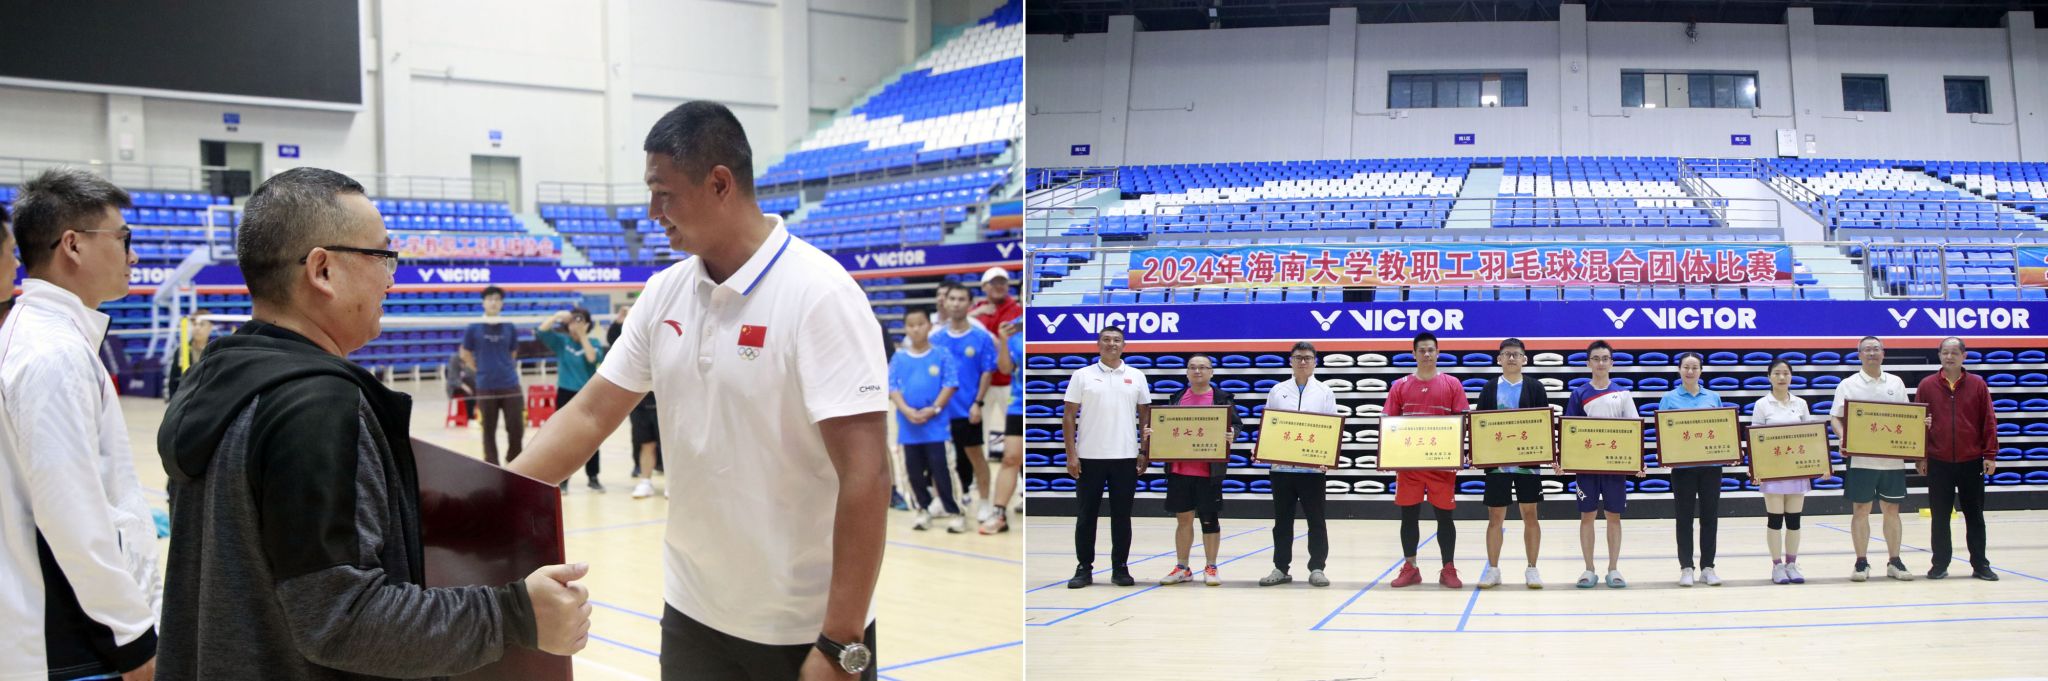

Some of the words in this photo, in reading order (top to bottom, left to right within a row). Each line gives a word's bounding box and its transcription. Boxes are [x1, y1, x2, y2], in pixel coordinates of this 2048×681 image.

[872, 249, 926, 268] VICTOR
[1143, 249, 1777, 284] 2024年海南大学教职工羽毛球混合团体比赛
[437, 268, 491, 282] VICTOR
[572, 268, 621, 282] VICTOR
[1073, 311, 1180, 334] VICTOR
[1348, 308, 1464, 331] VICTOR
[1641, 307, 1757, 330] VICTOR
[1923, 307, 2030, 330] VICTOR
[1172, 427, 1205, 438] 第七名
[1870, 422, 1903, 435] 第八名
[1283, 431, 1316, 443] 第五名
[1404, 436, 1438, 447] 第三名
[1495, 431, 1528, 442] 第一名
[1683, 430, 1716, 442] 第四名
[1584, 439, 1617, 450] 第一名
[1773, 445, 1806, 457] 第六名
